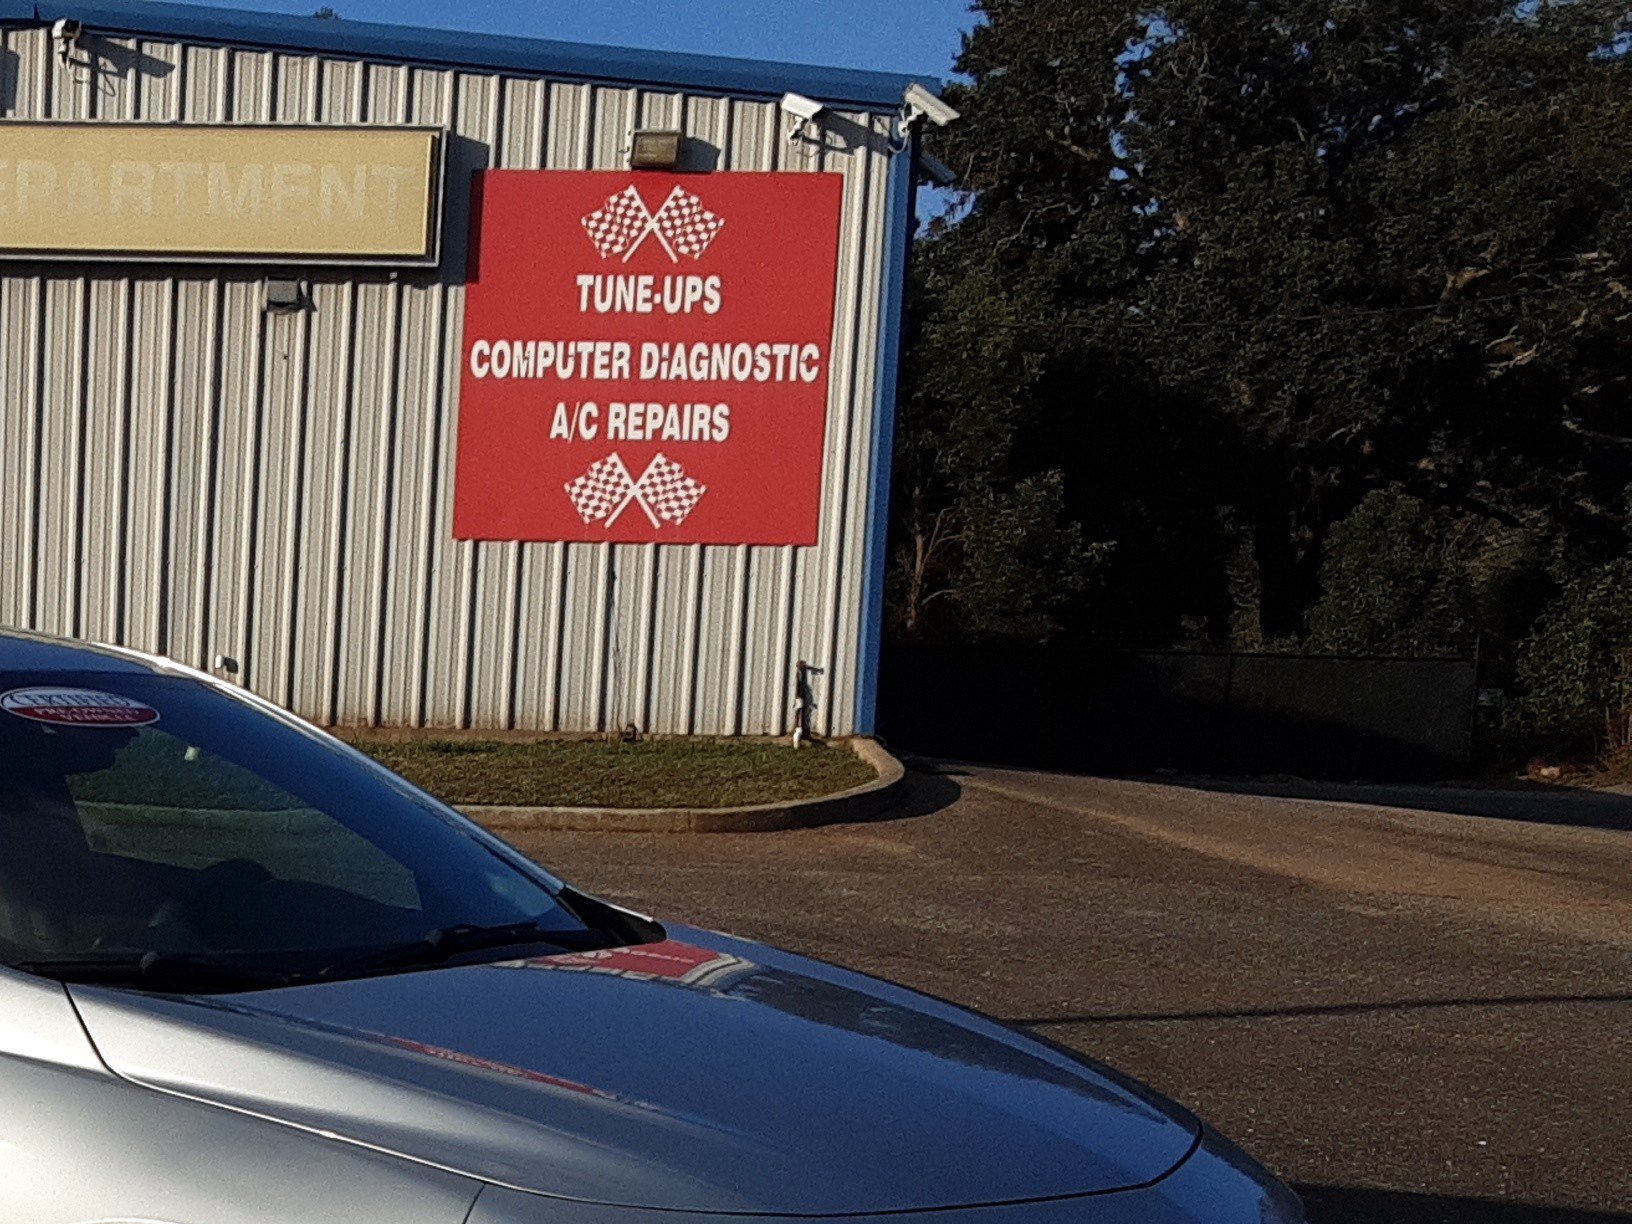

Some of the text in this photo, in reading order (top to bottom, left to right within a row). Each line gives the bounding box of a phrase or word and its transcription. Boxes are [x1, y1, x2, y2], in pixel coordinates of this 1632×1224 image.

[576, 274, 722, 315] TUNE-UPS
[470, 339, 821, 383] COMPUTER DIAGNOSTIC
[548, 401, 731, 443] A/C REPAIRS
